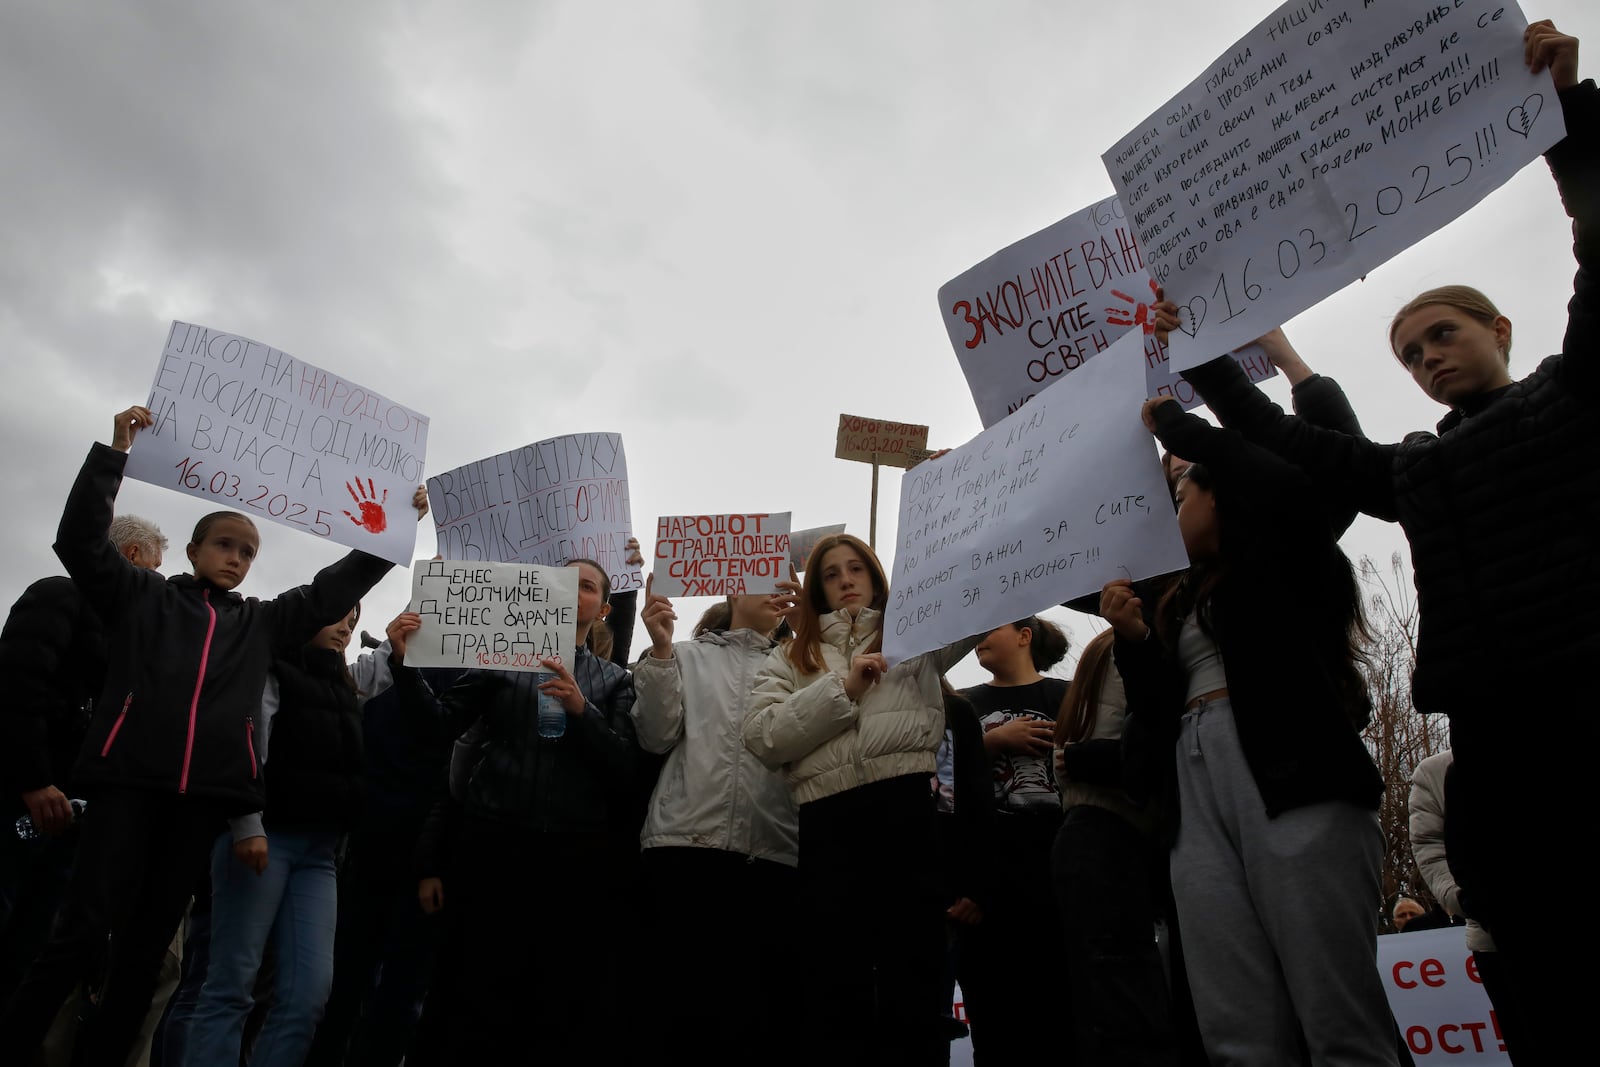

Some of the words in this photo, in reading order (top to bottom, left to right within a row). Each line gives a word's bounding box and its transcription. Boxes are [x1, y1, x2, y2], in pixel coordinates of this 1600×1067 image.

[1205, 48, 1252, 94] ГЛАСНА
[1267, 0, 1330, 41] ТИШИ
[1265, 93, 1277, 107] И
[1197, 217, 1207, 228] И
[1278, 163, 1292, 179] И
[1300, 127, 1350, 164] ГЛАСНО
[1140, 211, 1176, 246] ЖИВОТ
[1189, 193, 1200, 207] И
[1154, 262, 1170, 285] НО
[1215, 219, 1242, 243] ОВА
[953, 248, 1086, 349] ЗАКОНИТЕ
[1081, 227, 1145, 290] ВАЖ
[1028, 302, 1096, 348] СИТЕ
[167, 321, 260, 369] ГЛАСОТ
[261, 346, 293, 393] НА
[299, 366, 429, 444] НАРОДОТ
[840, 415, 881, 434] ХОРОР
[191, 413, 323, 496] ВЛАСТА
[310, 415, 353, 464] ОД
[355, 431, 425, 483] МОЛКОТ
[909, 467, 943, 503] ОВА
[956, 462, 1007, 501] ПОВИК
[1018, 443, 1045, 471] ДА
[175, 457, 333, 537] 16.03.2025
[969, 496, 987, 519] ЗА
[655, 536, 727, 559] СТРАДА
[731, 533, 790, 557] ДОДЕКА
[657, 514, 769, 539] НАРОДОТ
[421, 561, 492, 586] ДЕНЕС
[518, 569, 540, 585] НЕ
[610, 571, 643, 591] 025
[669, 556, 785, 579] СИСТЕМОТ
[896, 564, 959, 610] ЗАКОНОТ
[972, 540, 1023, 571] ВАЖИ
[1043, 520, 1068, 543] ЗА
[962, 588, 980, 608] ЗА
[1000, 547, 1100, 594] ЗАКОНОТ!!!
[446, 586, 549, 603] МОЛЧИМЕ!
[680, 578, 747, 597] УЖИВА
[419, 599, 491, 625] ДЕНЕС
[441, 631, 559, 664] ПРАВДА!
[1392, 958, 1447, 990] се
[1406, 1010, 1508, 1055] ост!
